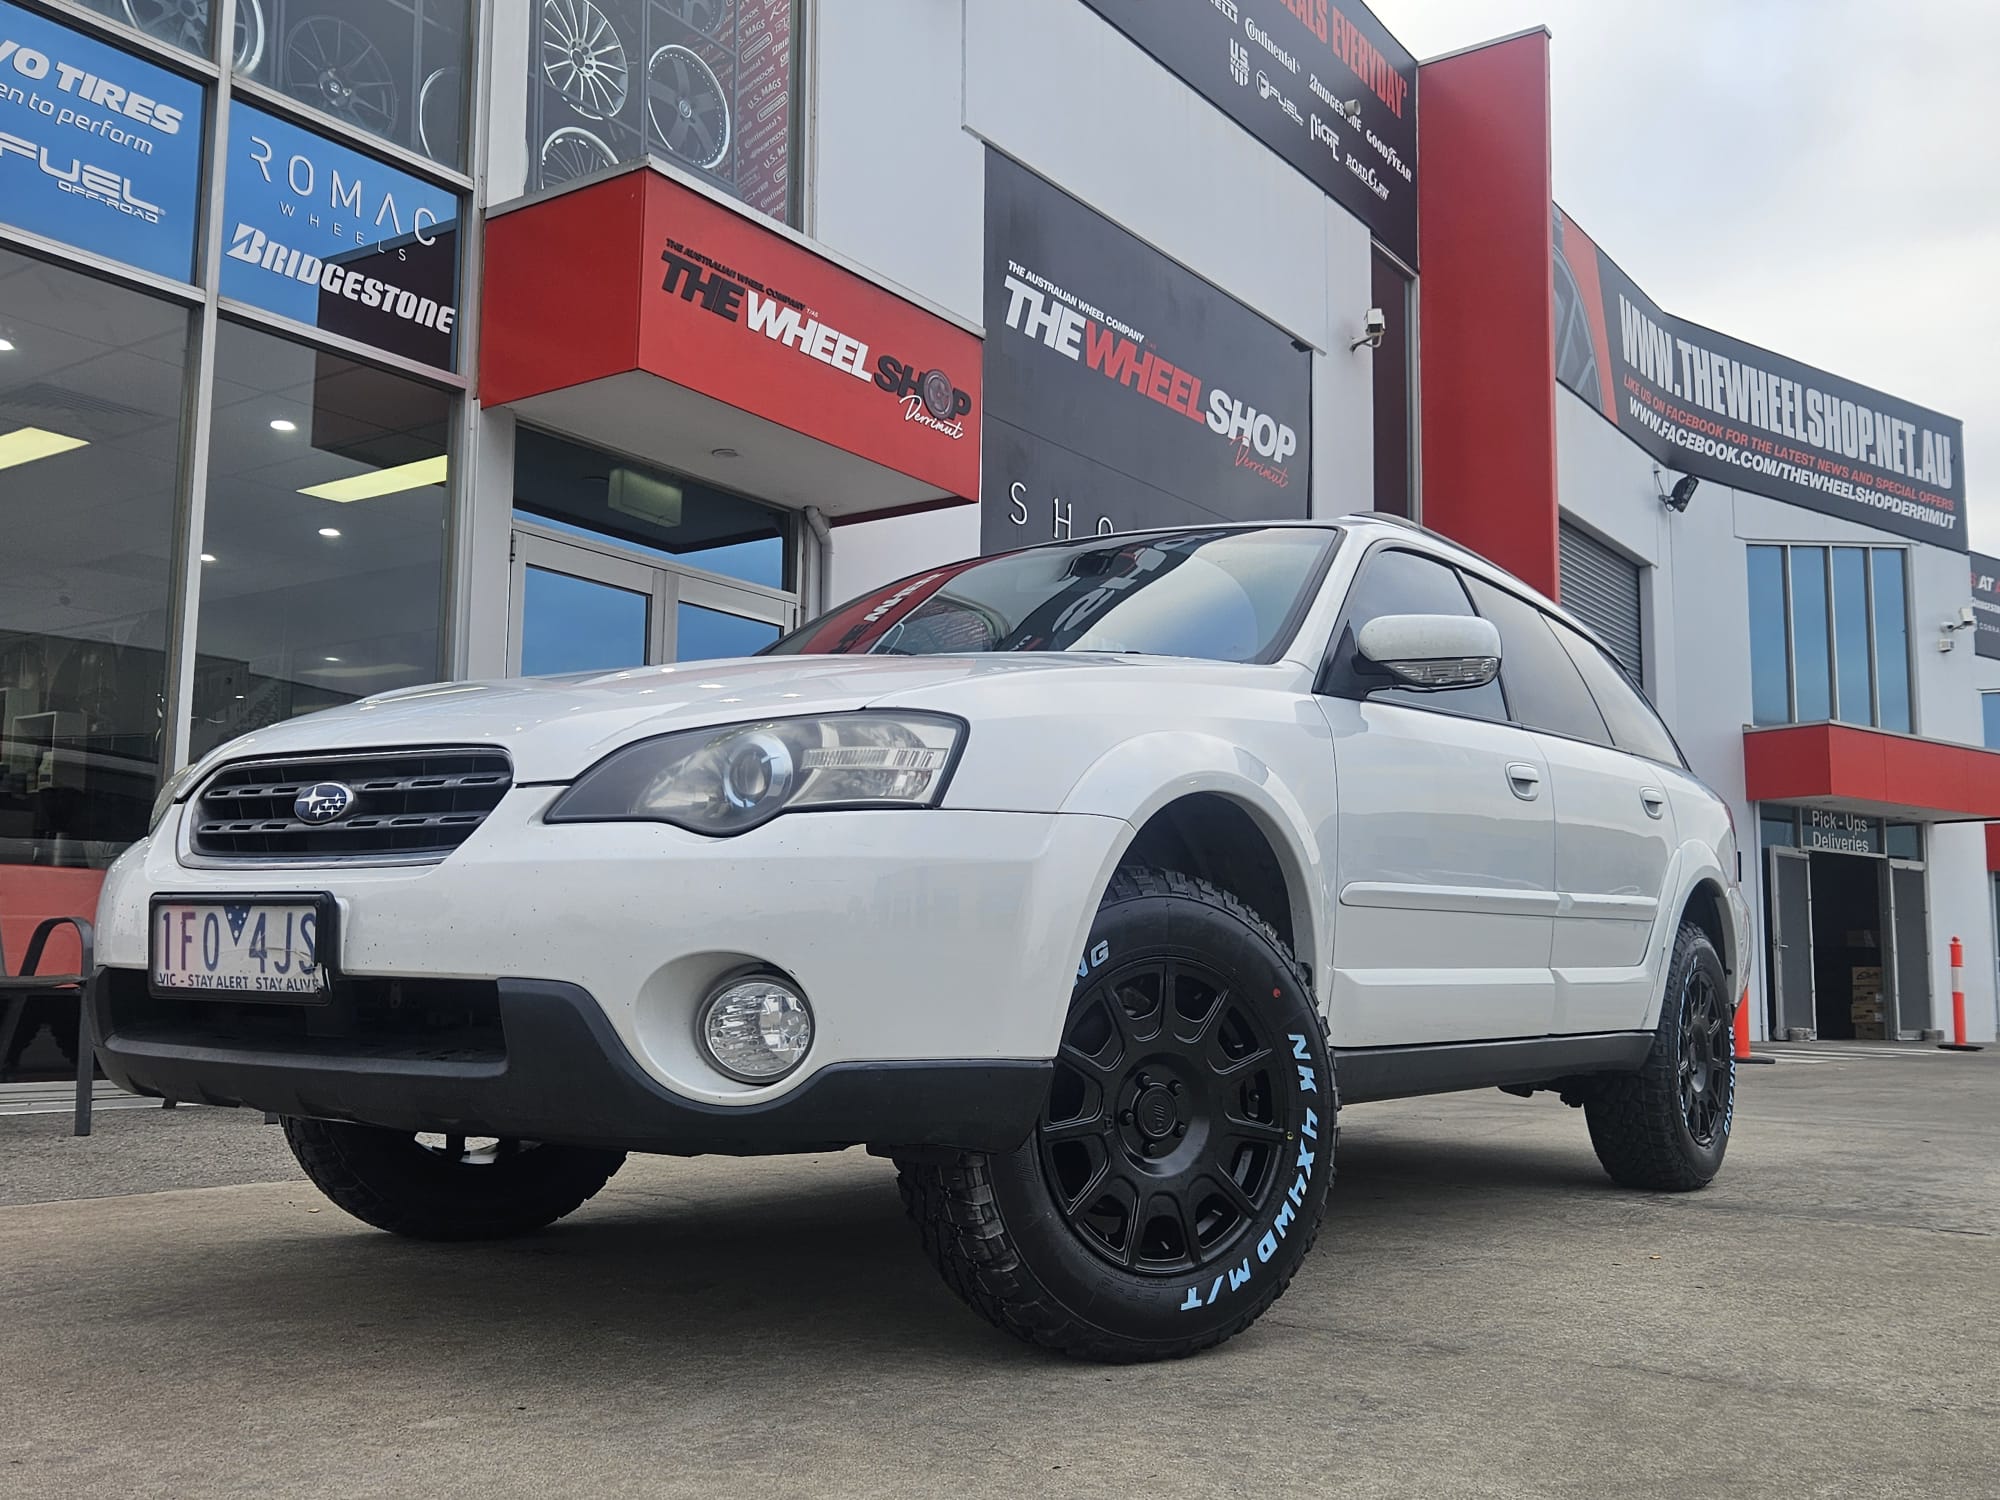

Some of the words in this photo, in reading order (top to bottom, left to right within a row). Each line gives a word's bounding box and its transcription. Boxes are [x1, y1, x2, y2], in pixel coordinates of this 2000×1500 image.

[1245, 17, 1295, 74] Continental
[28, 92, 54, 116] to
[56, 108, 153, 155] perform
[56, 62, 184, 134] TIRES
[0, 131, 159, 213] FUEL
[57, 180, 159, 224] OFF-ROAD
[250, 135, 437, 246] ROMAC
[280, 200, 407, 261] WHEELS
[225, 222, 456, 334] BRIDGESTONE
[666, 238, 684, 253] THE
[684, 249, 736, 279] AUSTRALIAN
[737, 273, 764, 292] WHEEL
[766, 287, 805, 311] COMPANY
[1008, 260, 1026, 277] THE
[1025, 271, 1078, 307] AUSTRALIAN
[1078, 299, 1105, 322] WHEEL
[1106, 315, 1144, 343] COMPANY
[661, 249, 746, 322] THE
[747, 289, 873, 383] WHEEL
[874, 355, 972, 421] SHOP
[1004, 275, 1087, 361] THE
[1086, 319, 1206, 425] WHEEL
[1205, 388, 1297, 463] SHOP
[899, 395, 964, 439] Derrimut
[1619, 293, 1952, 490] WWW.THEWHEELSHOP.NET.AU
[1624, 373, 1640, 395] LIKE
[1640, 386, 1651, 402] US
[1652, 396, 1666, 414] ON
[1665, 405, 1723, 438] FACEBOOK
[1725, 429, 1749, 447] FOR
[1751, 437, 1773, 454] THE
[1774, 445, 1816, 465] LATEST
[1817, 458, 1850, 478] NEWS
[1851, 470, 1874, 486] AND
[1875, 477, 1917, 500] SPECIAL
[1918, 490, 1954, 511] OFFERS
[1629, 396, 1956, 530] WWW.FACEBOOK.COM/THEWHEELSHOPDERRIMUT
[1812, 810, 1837, 829] Pick
[1846, 814, 1868, 836] Ups
[1813, 831, 1869, 852] Deliveries
[157, 973, 176, 986] VIC
[188, 974, 216, 988] STAY
[216, 976, 249, 989] ALERT
[256, 977, 283, 991] STAY
[1180, 1257, 1252, 1312] M/T
